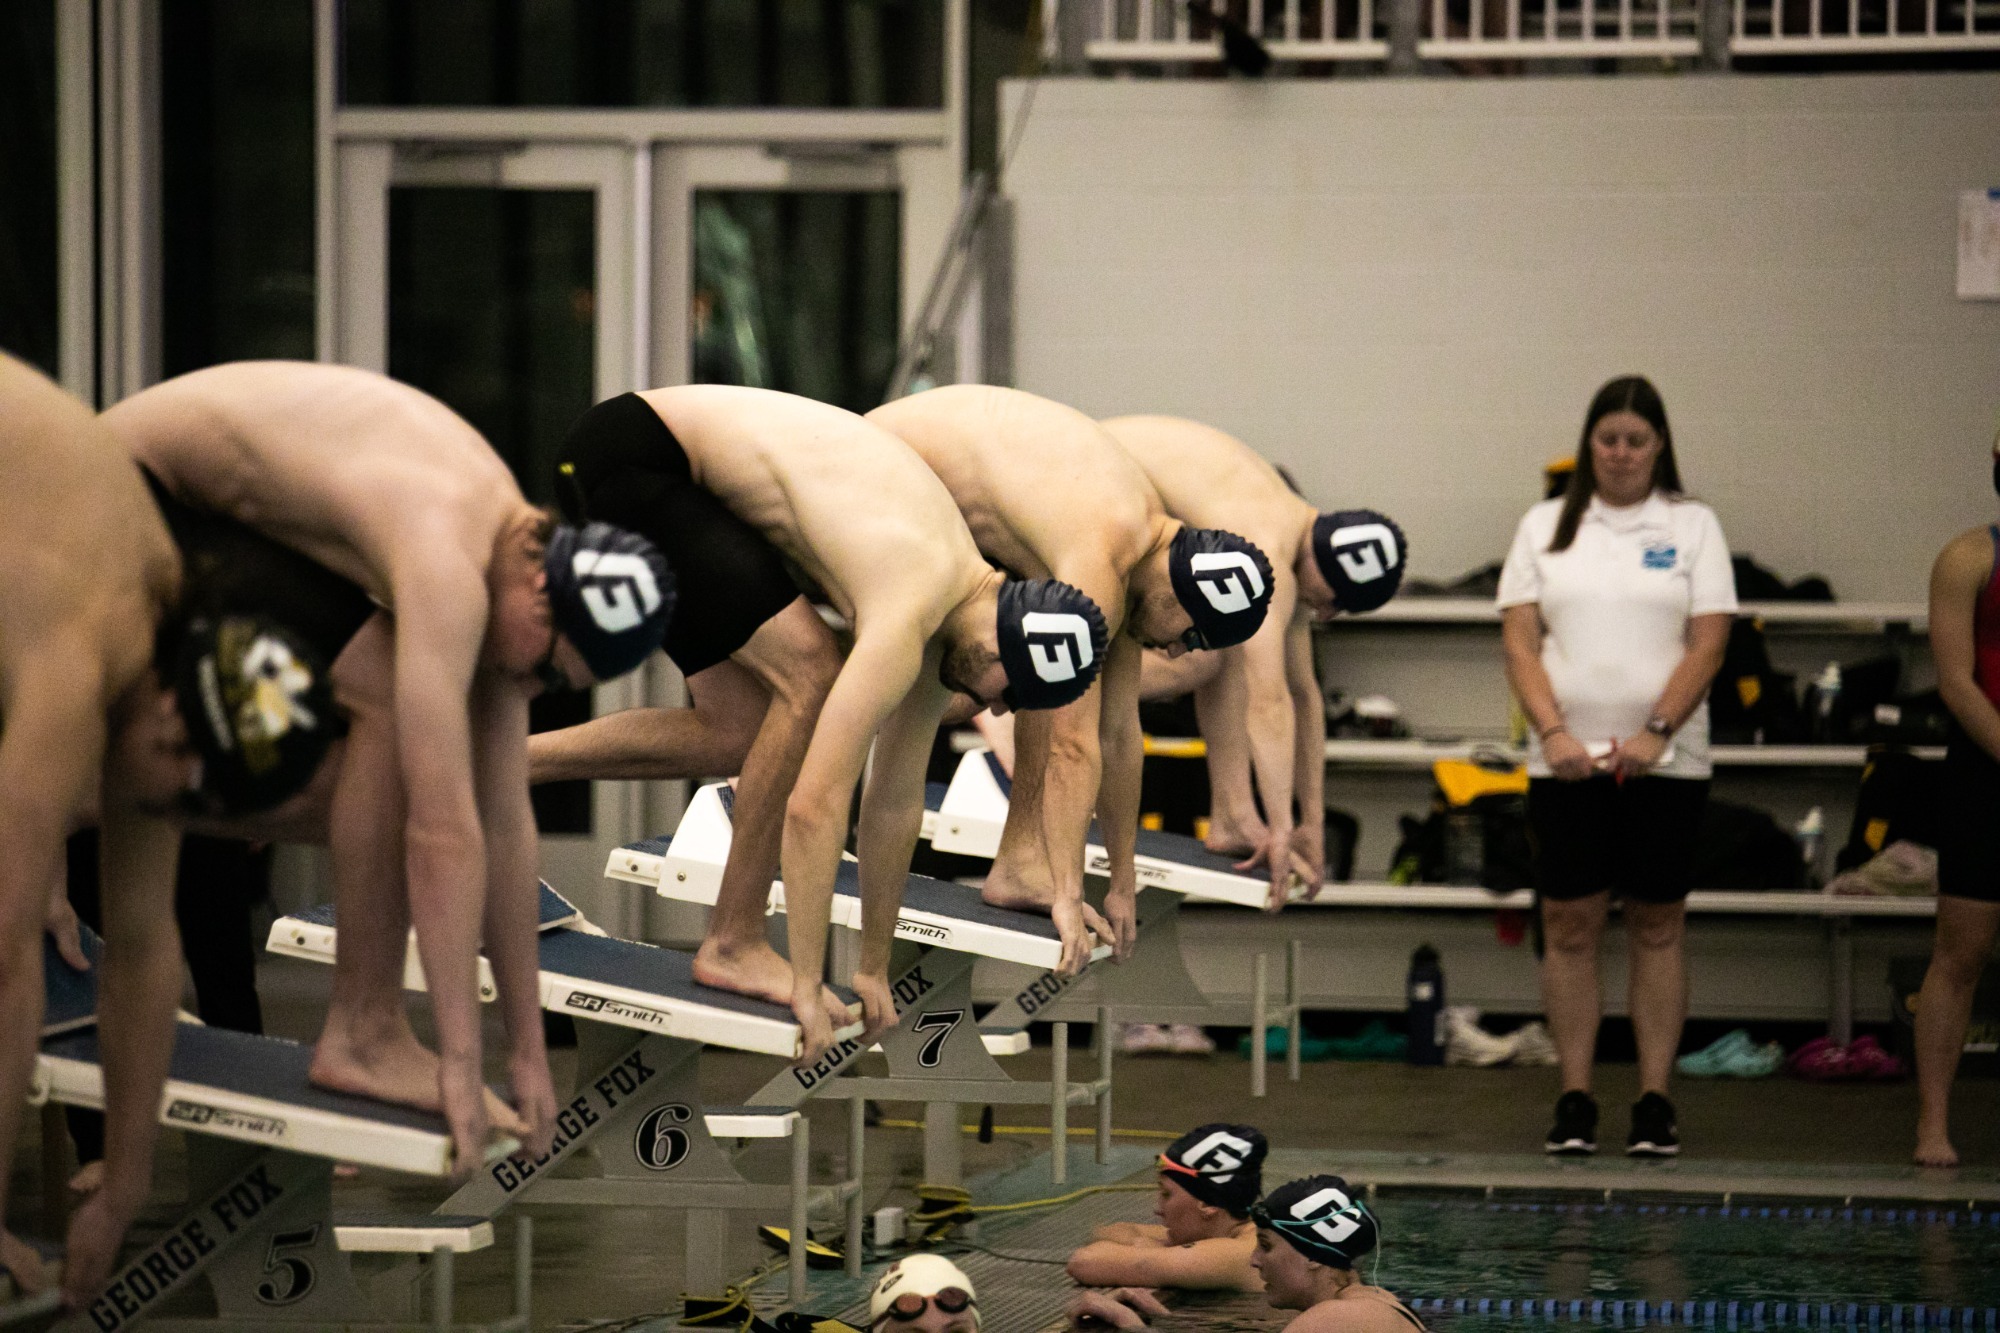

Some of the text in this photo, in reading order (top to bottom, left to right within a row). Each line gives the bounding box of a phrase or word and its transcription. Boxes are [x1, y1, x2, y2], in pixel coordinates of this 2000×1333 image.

[568, 992, 664, 1024] SR Smith
[890, 966, 934, 1015] OX
[912, 1009, 965, 1067] 7
[594, 1050, 656, 1108] FOX
[635, 1103, 693, 1170] 6
[89, 1164, 284, 1333] GEORGE FOX
[255, 1221, 322, 1306] 5
